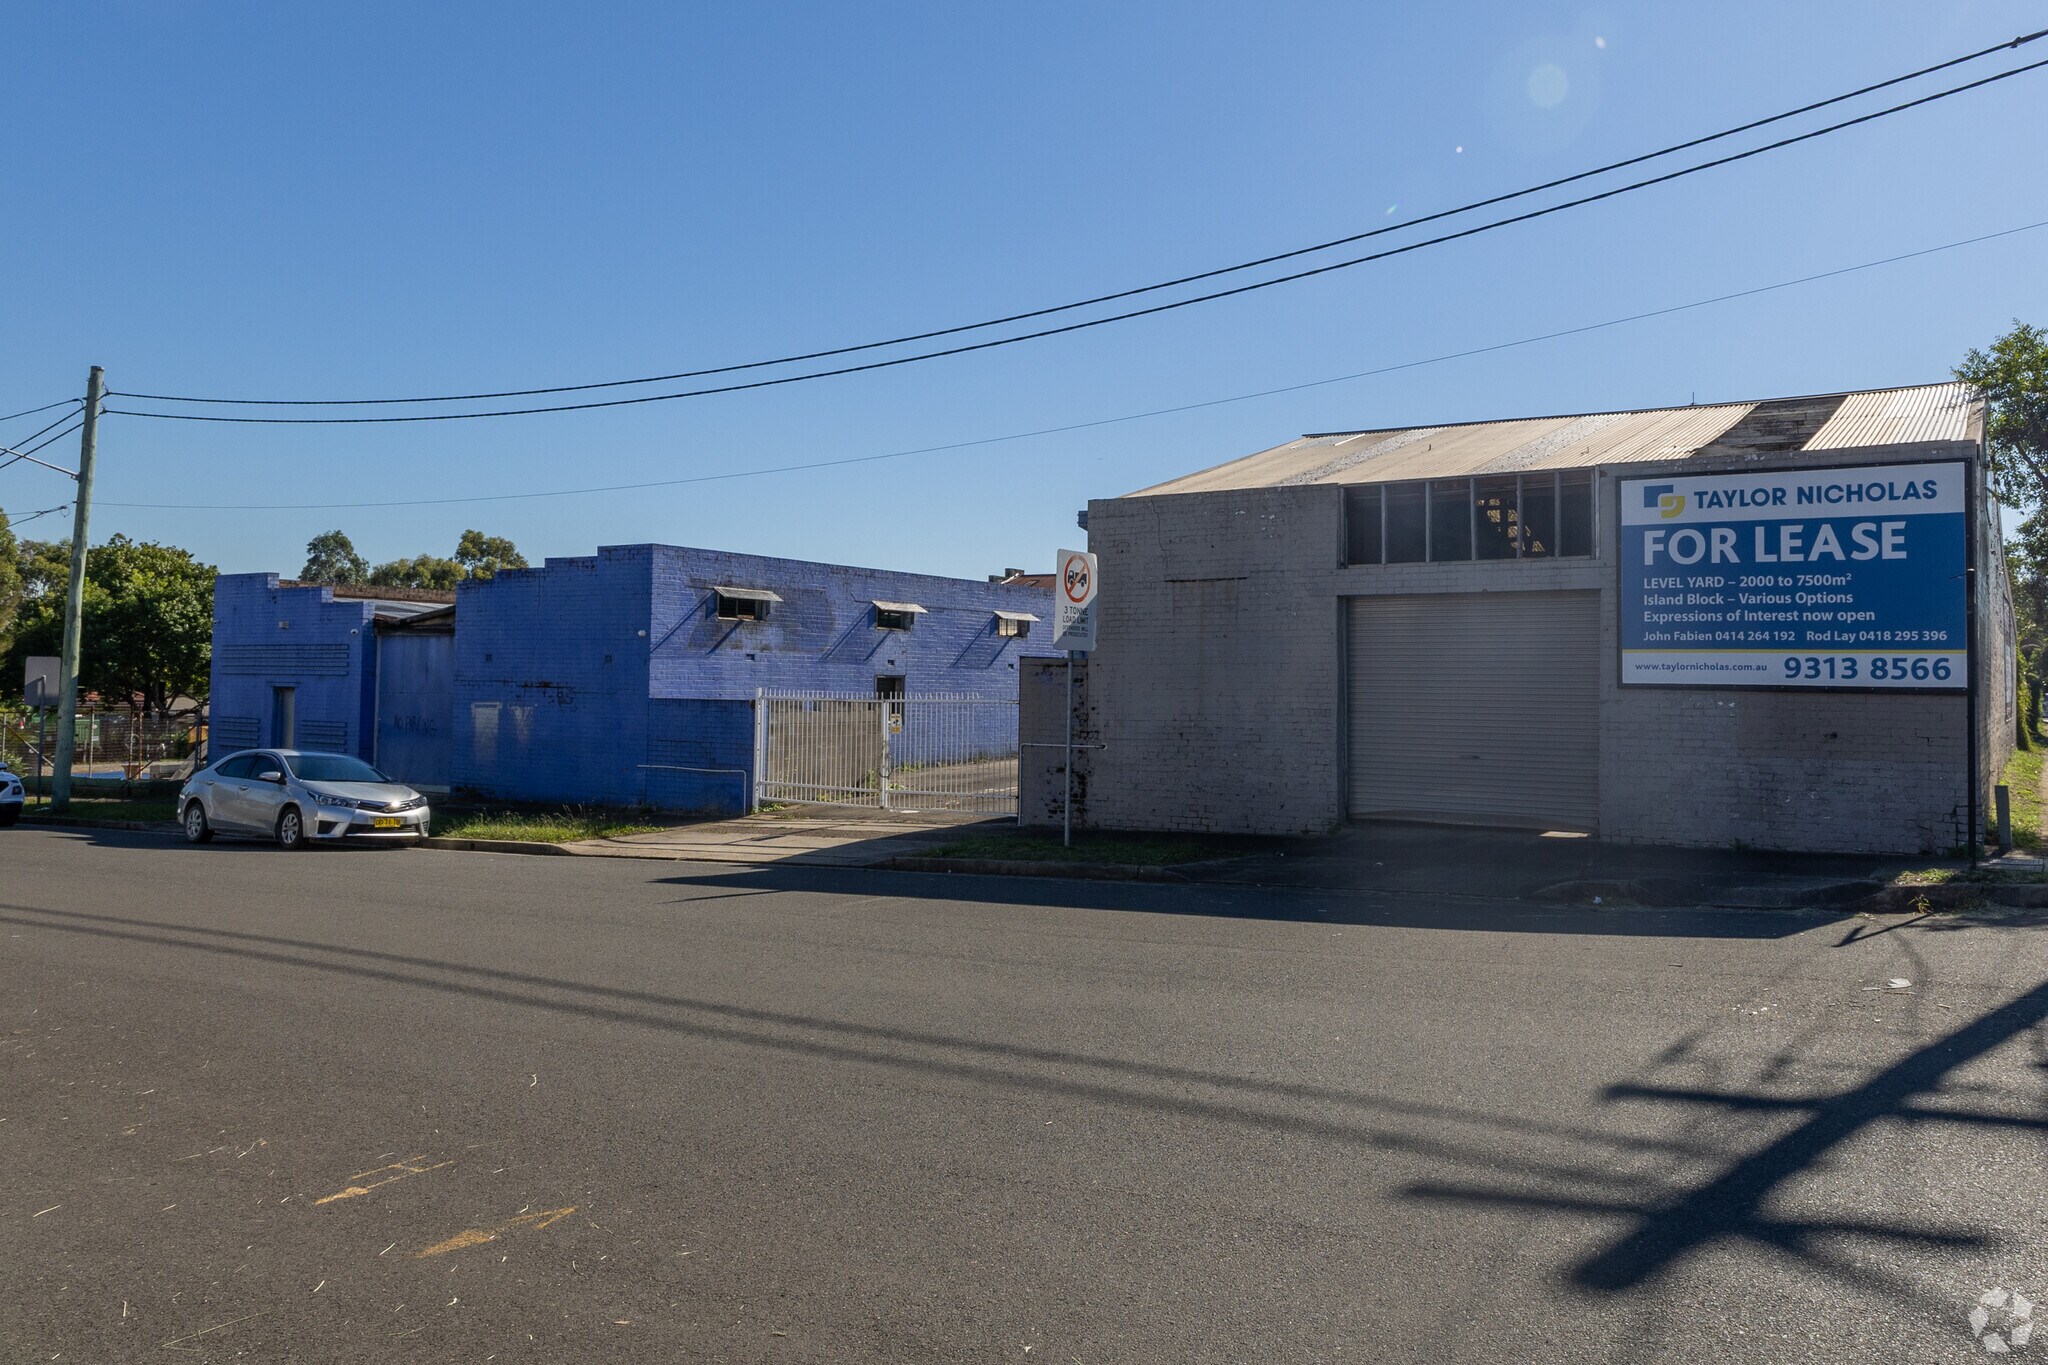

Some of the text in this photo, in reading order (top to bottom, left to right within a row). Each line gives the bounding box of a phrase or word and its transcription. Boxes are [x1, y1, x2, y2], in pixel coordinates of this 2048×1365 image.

[1694, 480, 1938, 509] TAYLOR NICHOLAS
[1644, 521, 1907, 566] FOR LEASE
[1643, 577, 1684, 589] LEVEL
[1687, 576, 1725, 588] YARD
[1739, 575, 1775, 587] 2000
[1778, 576, 1793, 587] to
[1643, 594, 1684, 606] Island
[1687, 593, 1725, 605] Block
[1738, 592, 1792, 604] Various
[1795, 592, 1853, 606] Options
[1064, 606, 1088, 616] 3 TONNE
[1643, 609, 1876, 625] Expressions of Interest now open
[1062, 615, 1076, 624] LOAD
[1643, 630, 1948, 643] John Fabien 0414 264 192 Rod Lay 0418 295 396
[1635, 656, 1952, 681] www.taylornicholas.com.au 9313 8566
